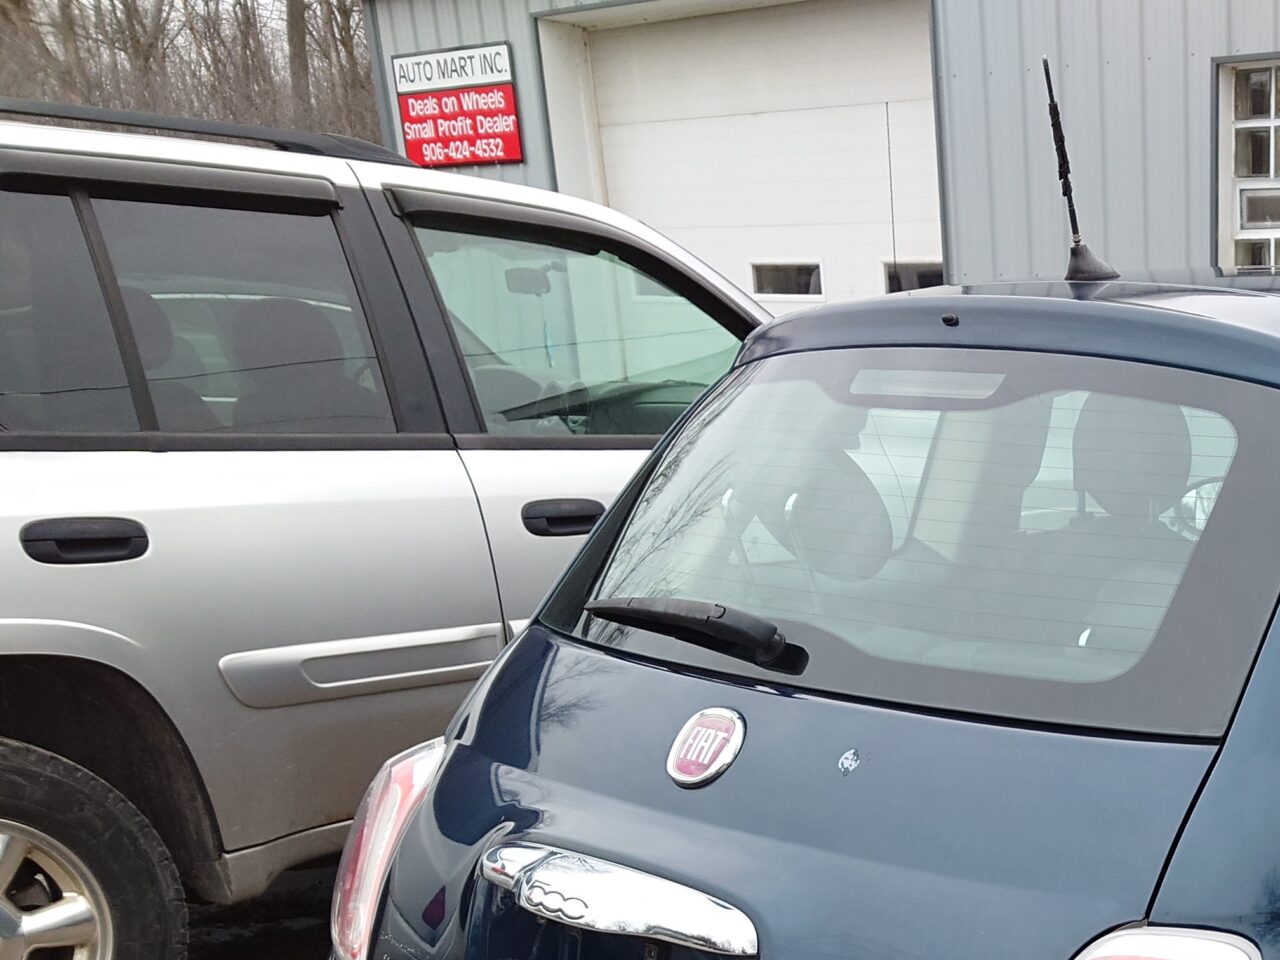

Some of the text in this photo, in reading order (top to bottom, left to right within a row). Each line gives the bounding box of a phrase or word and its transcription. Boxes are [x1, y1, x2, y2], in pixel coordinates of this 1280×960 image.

[399, 52, 508, 84] AUTO MART INC.
[408, 89, 505, 116] Deals on Wheels
[404, 113, 515, 139] Small Profit Dealer
[422, 138, 504, 161] 906-424-4532
[679, 726, 728, 764] FIAT
